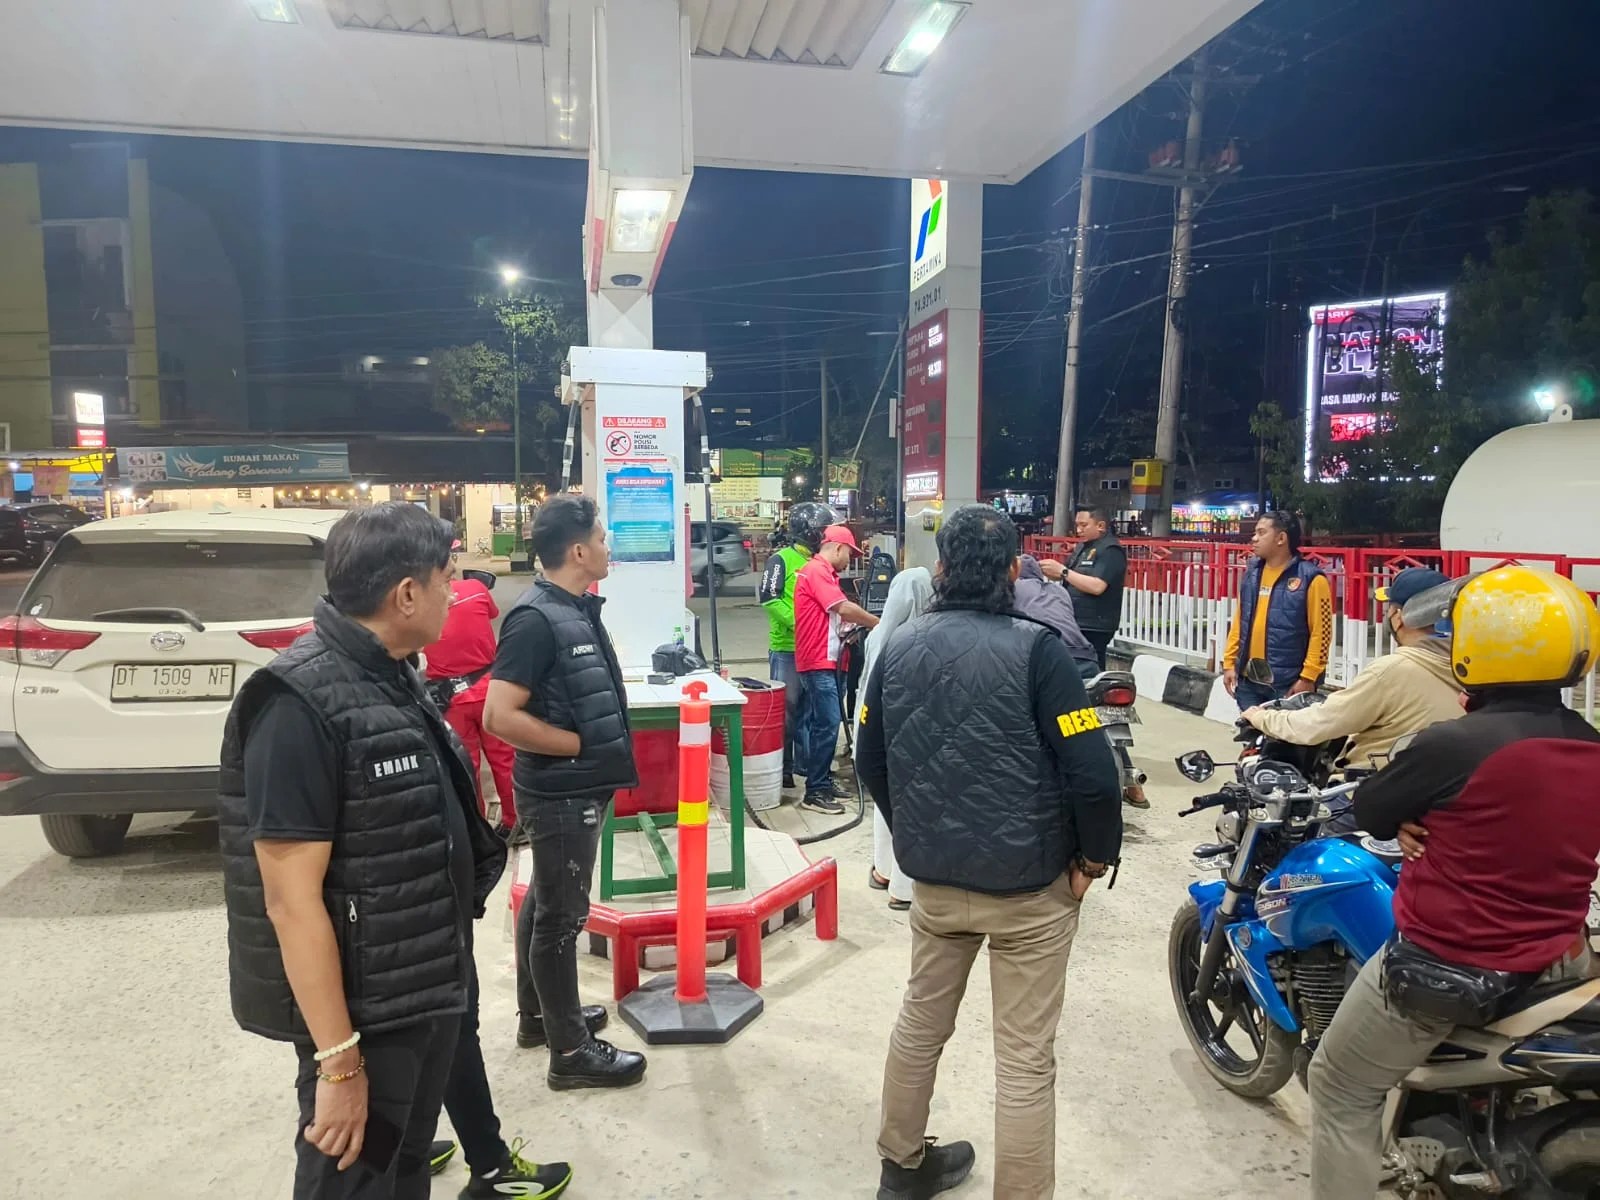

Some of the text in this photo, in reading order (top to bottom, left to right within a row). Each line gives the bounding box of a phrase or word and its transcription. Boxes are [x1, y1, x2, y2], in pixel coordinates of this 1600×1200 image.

[224, 453, 300, 463] RUMAH MAKAN
[116, 667, 230, 686] DT 1509 NF
